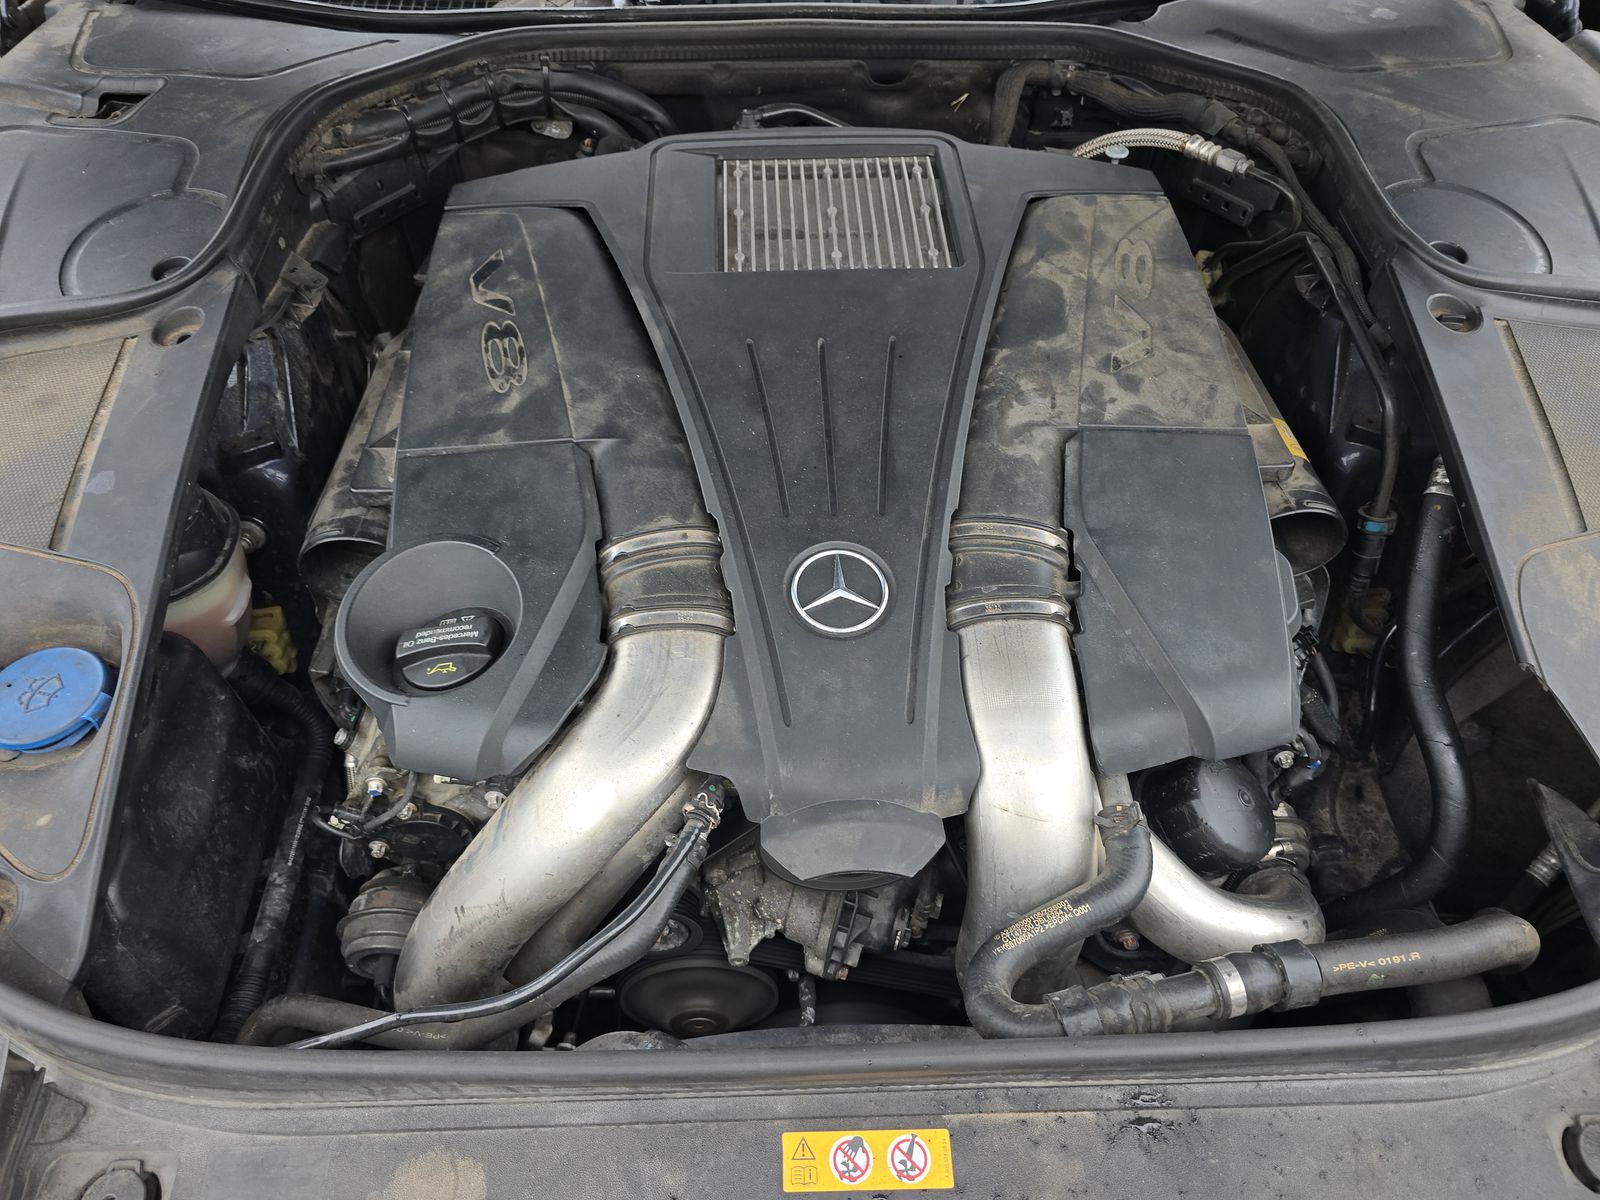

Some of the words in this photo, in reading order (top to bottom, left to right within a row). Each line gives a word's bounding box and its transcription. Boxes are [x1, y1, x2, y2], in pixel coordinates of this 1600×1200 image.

[1110, 238, 1154, 374] V8
[469, 248, 528, 393] V8
[416, 624, 473, 638] recommended
[416, 630, 479, 645] Mercedes-Benz
[403, 640, 415, 649] Oil
[1333, 960, 1376, 972] >PE-V<
[1378, 951, 1422, 966] 0191.R
